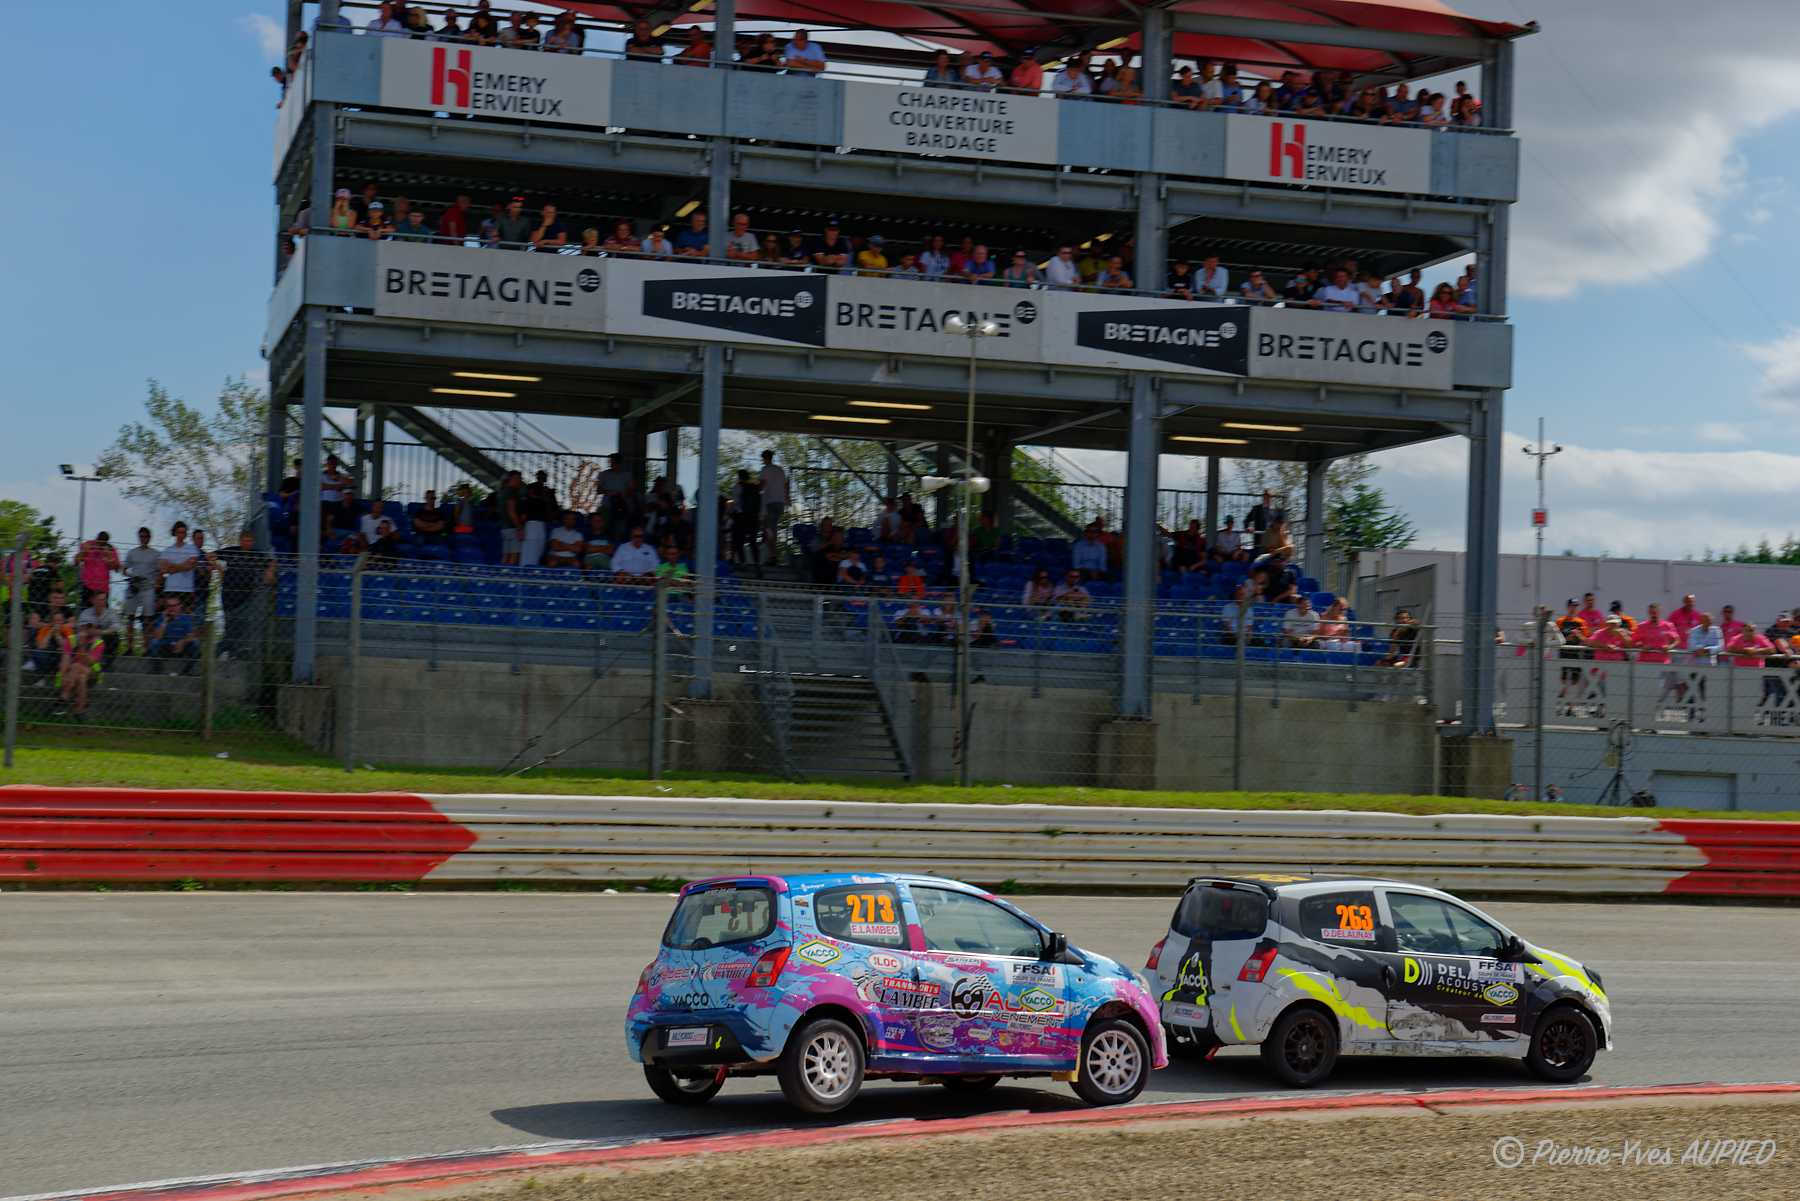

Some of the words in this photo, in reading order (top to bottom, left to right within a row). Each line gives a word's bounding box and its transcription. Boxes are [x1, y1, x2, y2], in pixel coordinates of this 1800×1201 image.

[898, 92, 1008, 115] CHARPENTE
[889, 111, 1015, 135] COUVERTURE
[906, 132, 999, 152] BARDAGE
[386, 268, 573, 306] BRETAGNE
[671, 291, 796, 317] BRETAGNE
[1103, 322, 1220, 347] BRETAGNE
[1258, 333, 1424, 367] BRETAGNE
[846, 894, 895, 923] 273
[1336, 905, 1375, 930] 263
[851, 925, 898, 935] E.LAMBEC
[1013, 964, 1051, 976] FFSA
[1479, 961, 1513, 972] FFSA
[673, 991, 709, 1008] YACCO
[1023, 995, 1052, 1006] YACCO
[1489, 989, 1515, 999] YACCO
